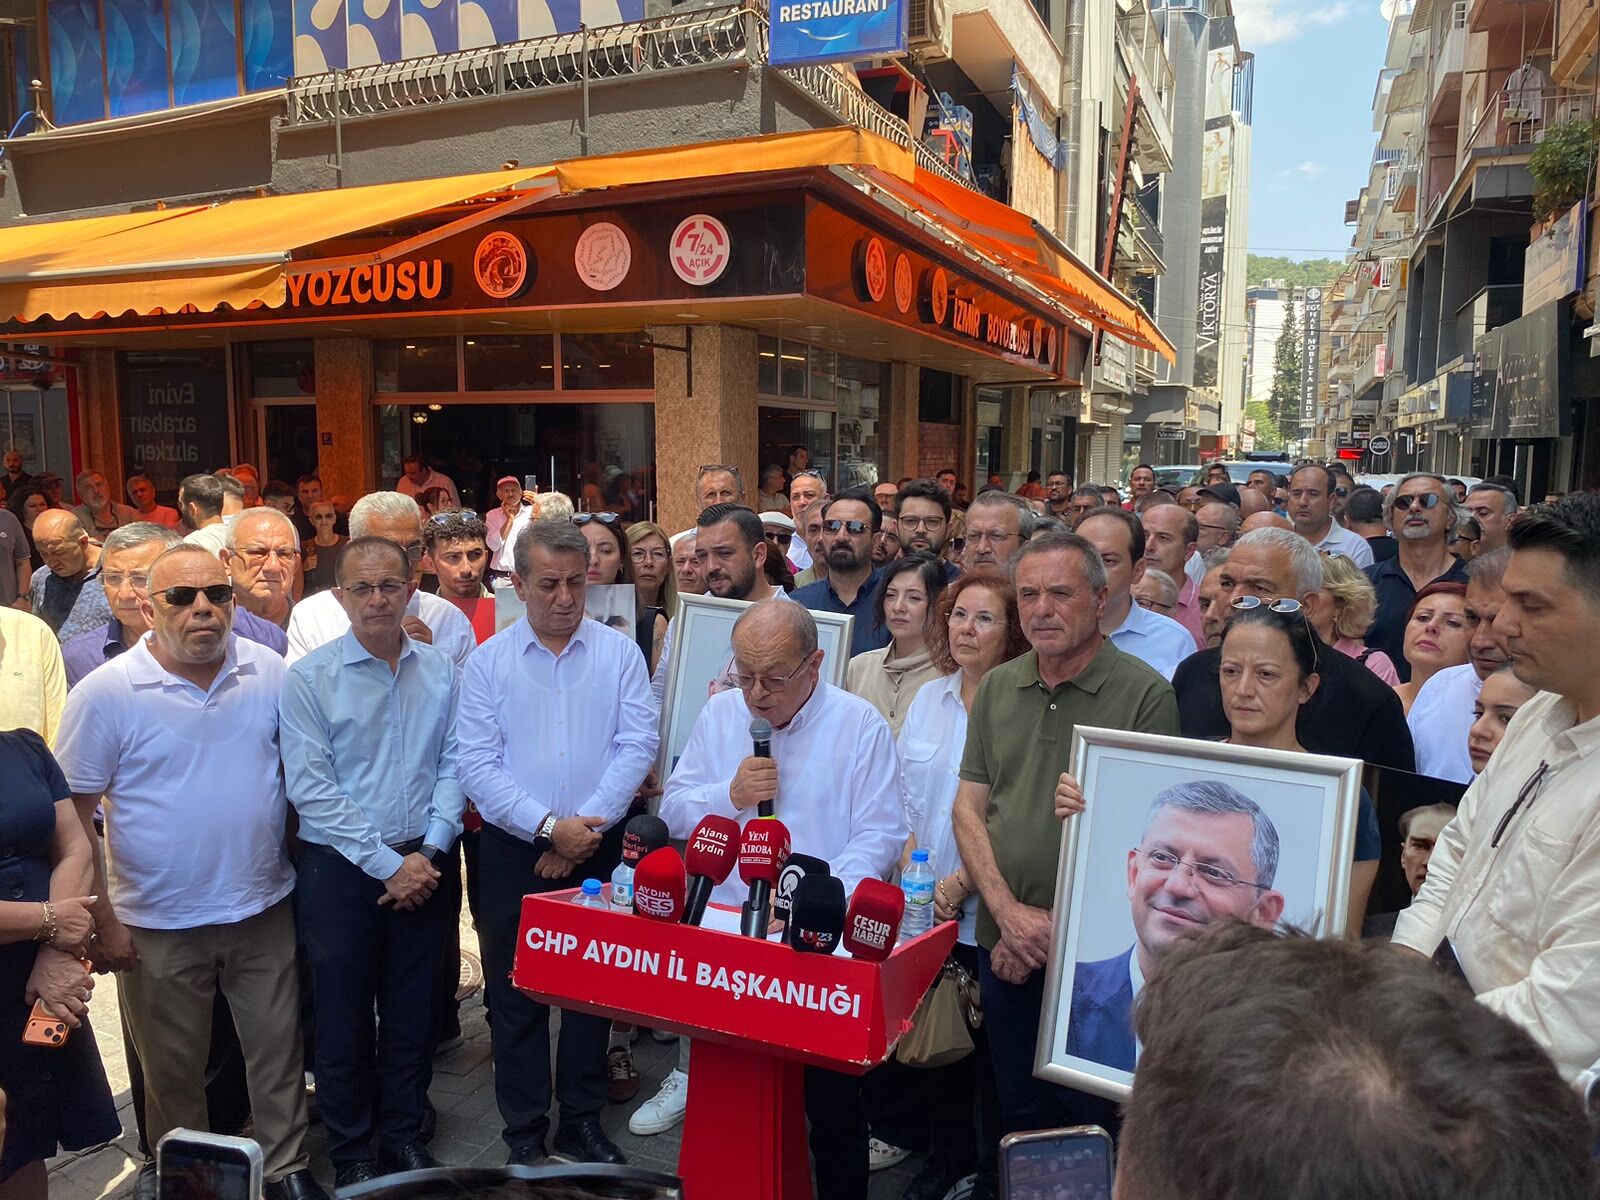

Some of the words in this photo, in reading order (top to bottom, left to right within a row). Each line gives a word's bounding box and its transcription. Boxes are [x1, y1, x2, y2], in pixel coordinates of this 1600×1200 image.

[779, 0, 888, 22] RESTAURANT
[687, 232, 714, 256] 7/24
[688, 257, 711, 270] AÇIK
[262, 259, 442, 309] YOZCUSU
[953, 288, 981, 339] İZMİR
[698, 826, 729, 841] Ajans
[748, 831, 769, 842] YENİ
[692, 841, 725, 856] Aydın
[740, 843, 772, 855] KIROBA
[638, 885, 670, 898] AYDIN
[637, 894, 672, 911] SES
[853, 914, 891, 937] CESUR
[853, 927, 886, 946] HABER
[525, 927, 578, 956] CHP
[582, 940, 660, 975] AYDIN
[667, 949, 688, 982] İL
[695, 962, 861, 1018] BAŞKANLIĞI
